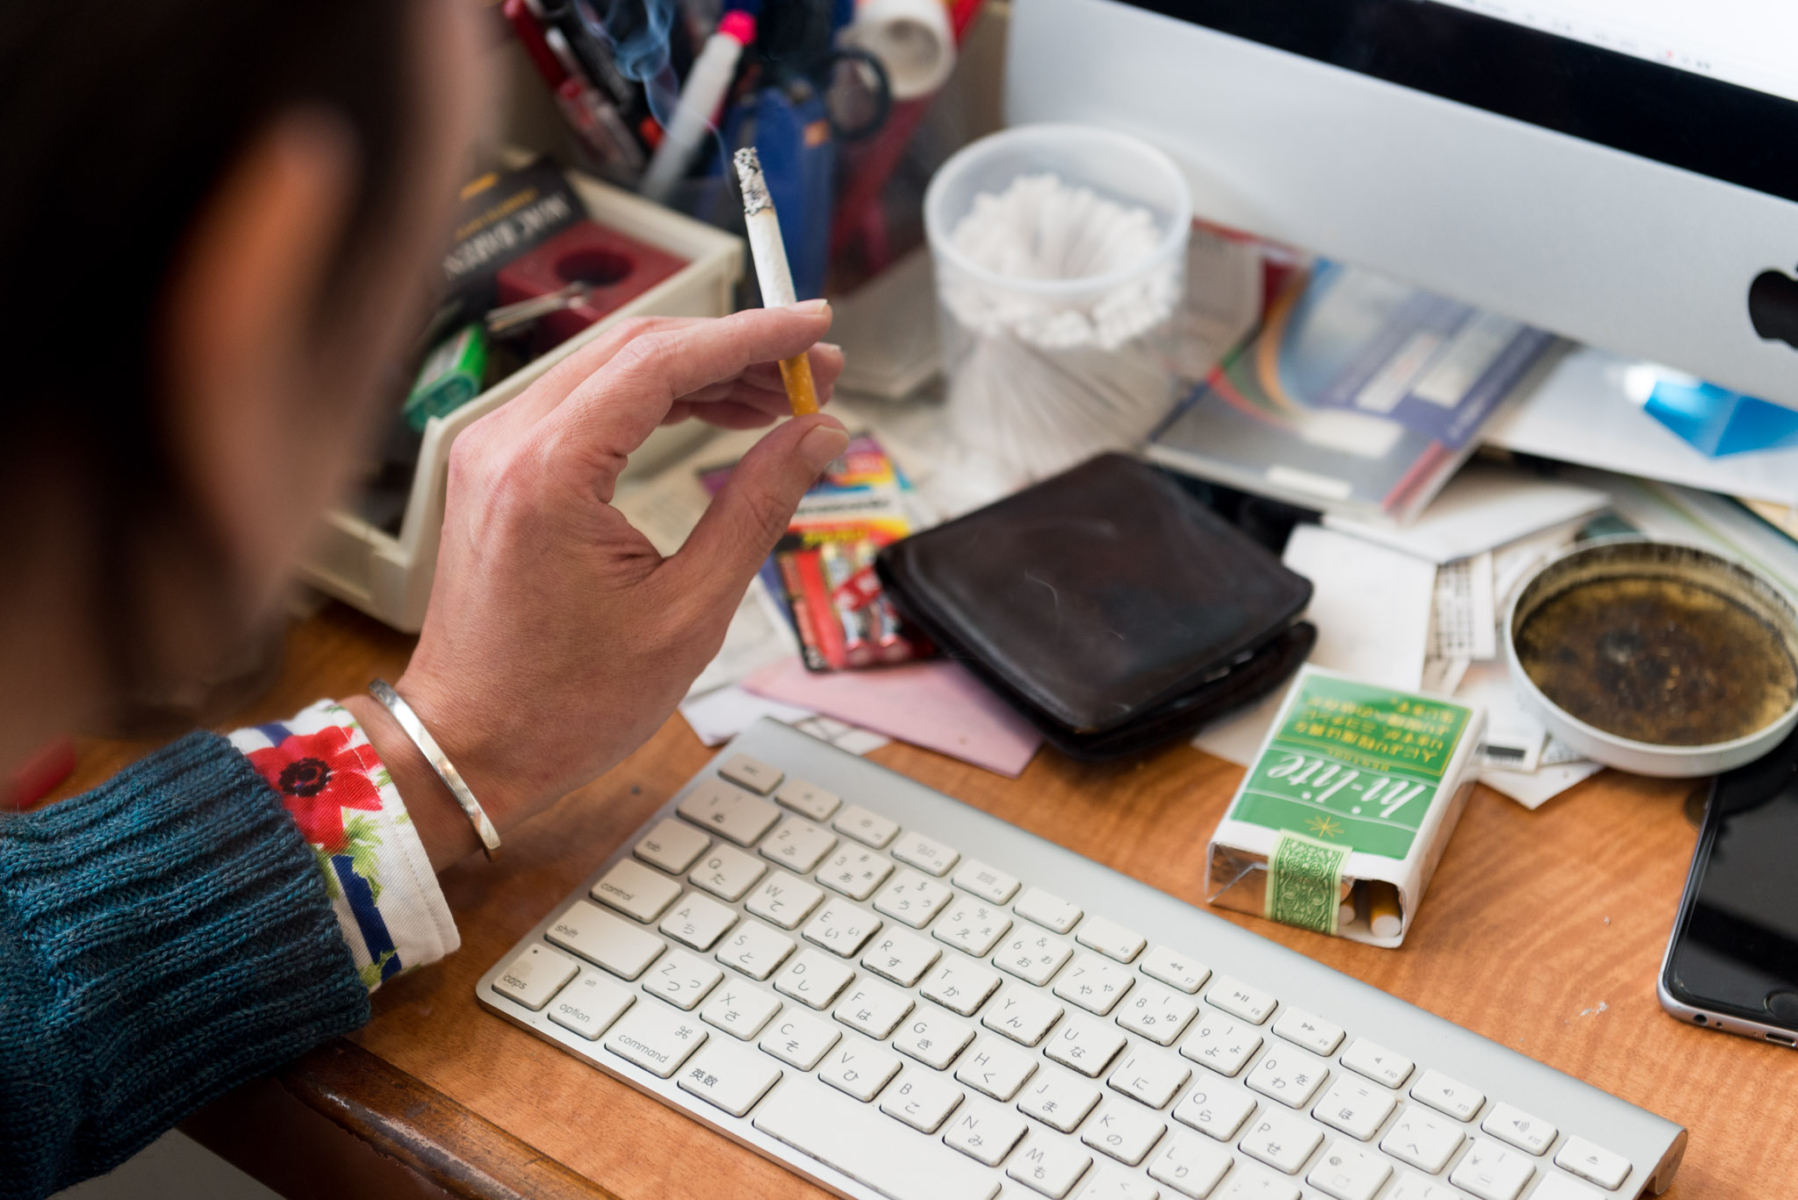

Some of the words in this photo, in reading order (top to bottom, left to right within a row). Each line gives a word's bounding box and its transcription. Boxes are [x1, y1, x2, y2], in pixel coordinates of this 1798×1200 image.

[1267, 755, 1427, 819] hi-lite
[778, 830, 791, 841] 2
[707, 858, 722, 870] Q
[834, 856, 847, 866] 3
[710, 872, 726, 886] た
[838, 872, 854, 884] あ
[601, 882, 635, 902] control
[765, 884, 784, 898] W
[893, 885, 906, 895] 4
[770, 900, 786, 913] て
[678, 908, 692, 920] A
[820, 910, 834, 923] E
[952, 912, 966, 922] 5
[555, 924, 579, 938] shift
[682, 922, 696, 935] ち
[825, 927, 840, 940] い
[956, 928, 972, 940] え
[734, 934, 748, 946] S
[880, 940, 894, 952] R
[1012, 940, 1024, 950] 6
[739, 952, 754, 964] と
[886, 956, 902, 968] す
[1016, 956, 1032, 968] お
[661, 964, 677, 976] Z
[792, 962, 806, 976] D
[940, 968, 954, 980] T
[1072, 967, 1086, 978] 7
[502, 974, 528, 990] caps
[666, 980, 681, 992] つ
[798, 980, 810, 992] し
[942, 986, 960, 998] か
[1079, 984, 1094, 996] や
[720, 992, 737, 1006] X
[851, 992, 865, 1002] F
[1136, 998, 1148, 1008] 8
[1004, 998, 1016, 1010] Y
[559, 1002, 590, 1024] option
[724, 1010, 741, 1022] さ
[856, 1008, 874, 1022] は
[1250, 1007, 1261, 1016] F8
[1006, 1016, 1024, 1029] ん
[1141, 1014, 1156, 1026] ゆ
[780, 1023, 794, 1036] C
[913, 1022, 928, 1034] G
[1200, 1028, 1211, 1038] 9
[1064, 1028, 1080, 1042] U
[618, 1033, 670, 1064] command
[786, 1039, 800, 1053] そ
[917, 1038, 933, 1051] き
[1318, 1038, 1329, 1047] F9
[841, 1051, 856, 1064] V
[1069, 1046, 1086, 1059] な
[1204, 1046, 1220, 1058] よ
[974, 1052, 990, 1066] H
[689, 1068, 719, 1088] 英数
[843, 1069, 859, 1082] ひ
[983, 1070, 996, 1084] く
[1294, 1073, 1310, 1087] を
[900, 1082, 913, 1096] B
[1036, 1084, 1050, 1094] J
[1132, 1076, 1150, 1091] に
[1271, 1076, 1286, 1089] わ
[904, 1101, 920, 1114] こ
[1042, 1100, 1058, 1114] ま
[1100, 1113, 1116, 1128] K
[1199, 1109, 1213, 1123] ら
[1338, 1107, 1354, 1121] ほ
[962, 1115, 980, 1130] N
[1257, 1122, 1272, 1135] P
[967, 1134, 984, 1148] み
[1106, 1134, 1123, 1146] の
[1166, 1146, 1176, 1160] L
[1266, 1141, 1282, 1156] せ
[1025, 1148, 1045, 1164] M
[1033, 1166, 1046, 1180] も
[1174, 1165, 1189, 1178] り
